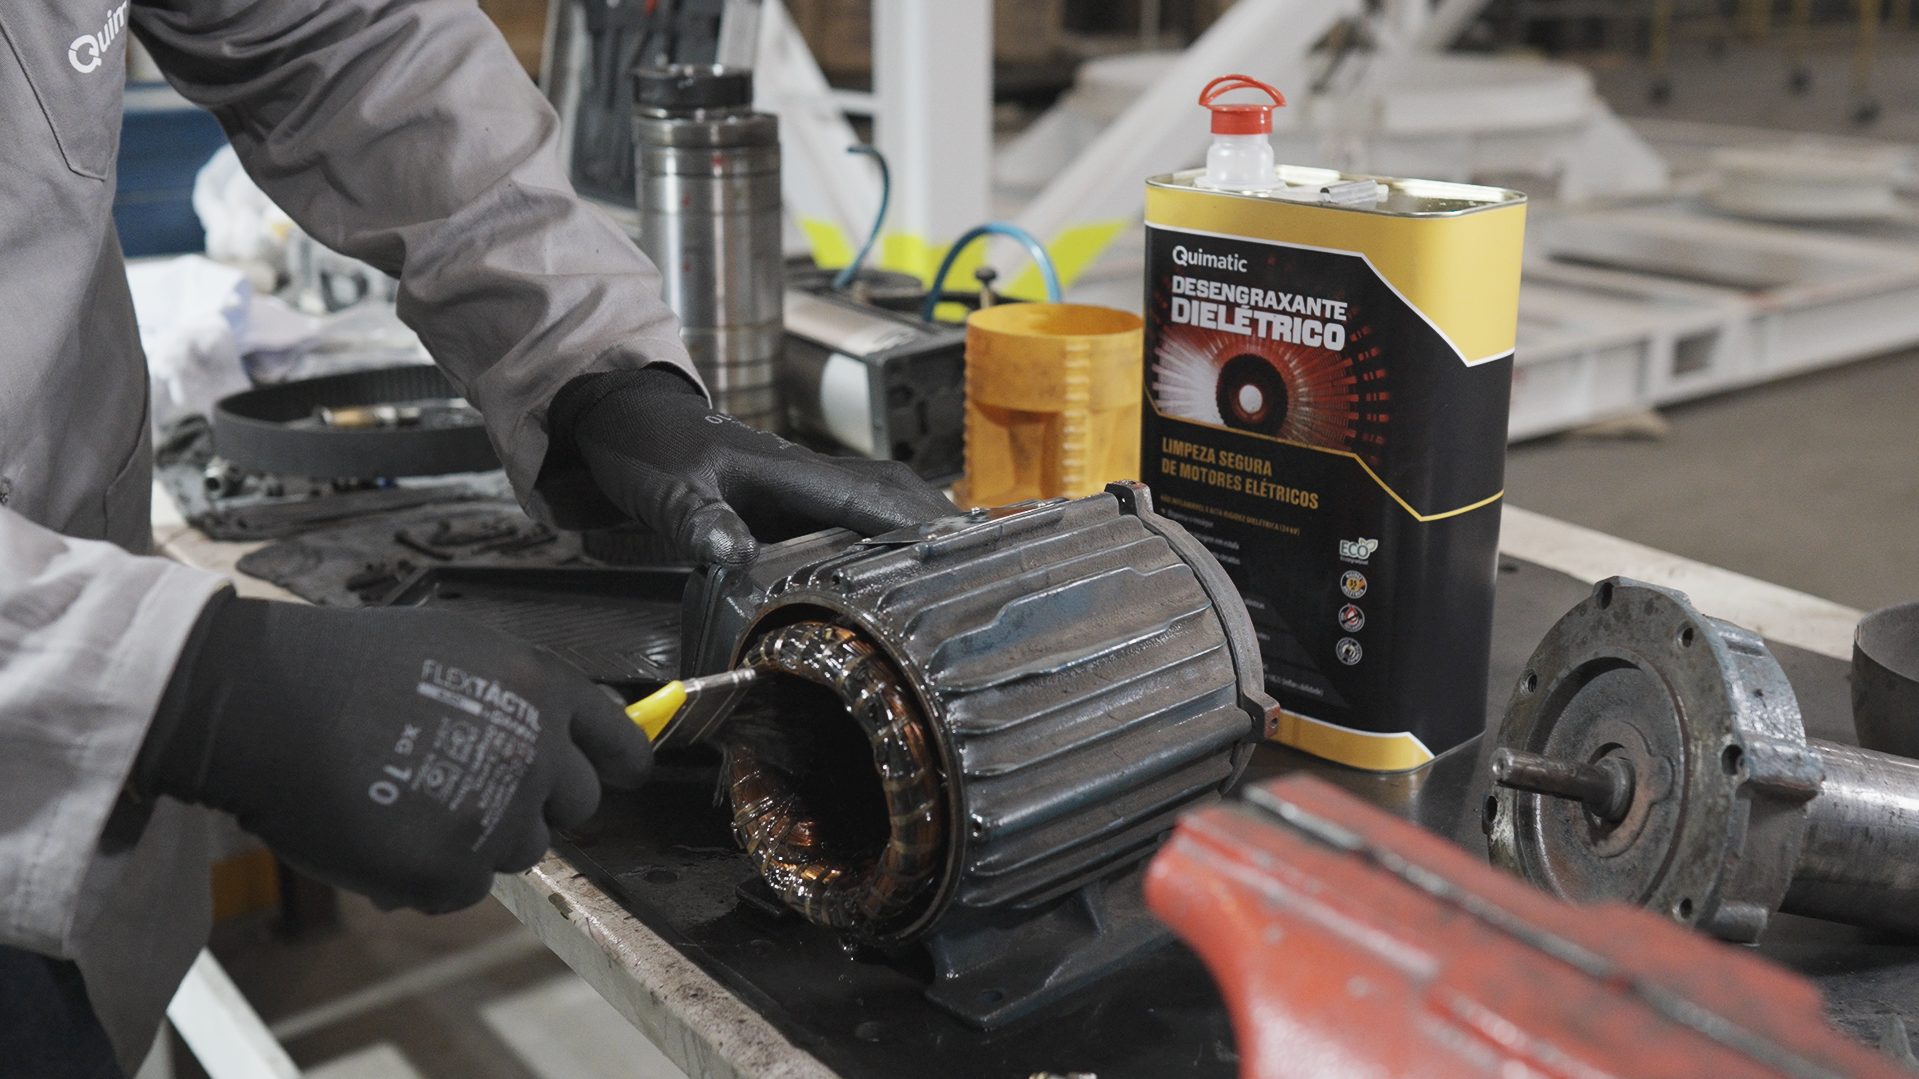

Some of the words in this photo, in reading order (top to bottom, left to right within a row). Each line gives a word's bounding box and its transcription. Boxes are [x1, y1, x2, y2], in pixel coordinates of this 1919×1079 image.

[1172, 245, 1248, 272] Quimatic
[1172, 275, 1347, 321] DESENGRAXANTE
[1171, 297, 1346, 351] DIELÉTRICO
[1162, 437, 1216, 464] LIMPEZA
[1219, 450, 1272, 477] SEGURA
[1161, 458, 1177, 476] DE
[1180, 462, 1242, 492] MOTORES
[1245, 478, 1319, 510] ELÉTRICOS
[1340, 540, 1370, 559] ECO
[368, 764, 413, 805] 10
